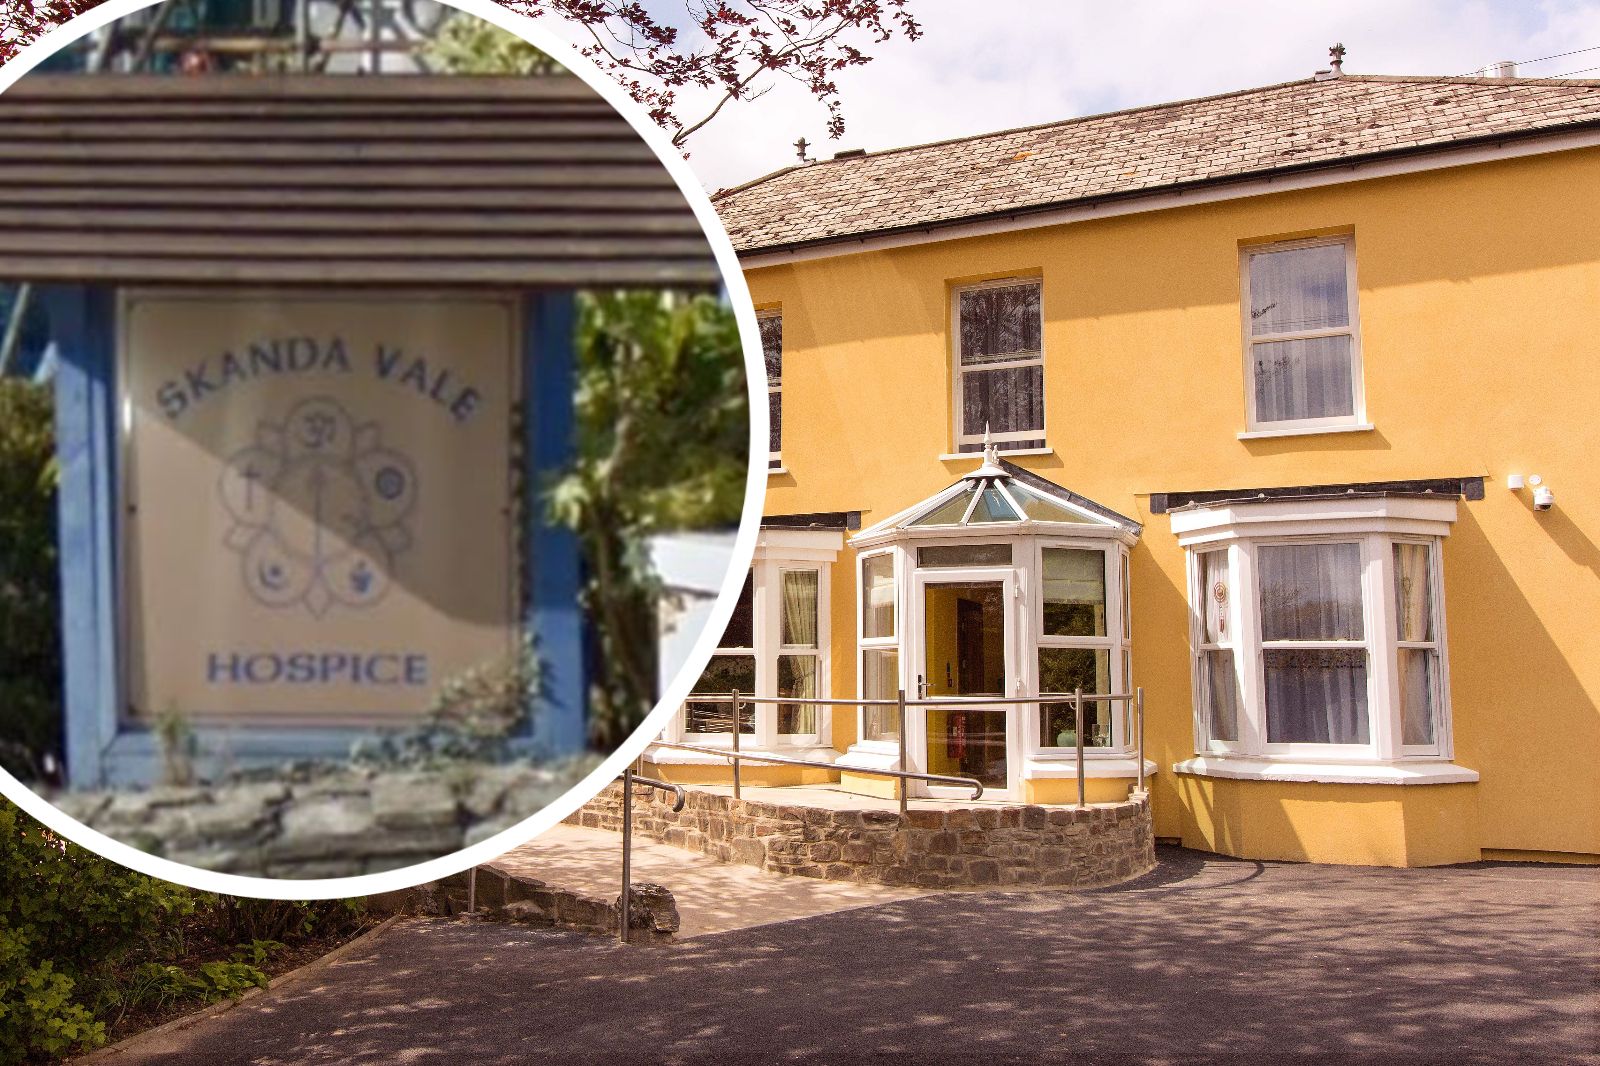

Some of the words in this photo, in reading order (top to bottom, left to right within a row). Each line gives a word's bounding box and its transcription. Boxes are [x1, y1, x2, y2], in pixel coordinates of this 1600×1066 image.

[156, 336, 351, 419] SKANDA
[373, 344, 481, 422] VALE
[207, 652, 427, 684] HOSPICE
